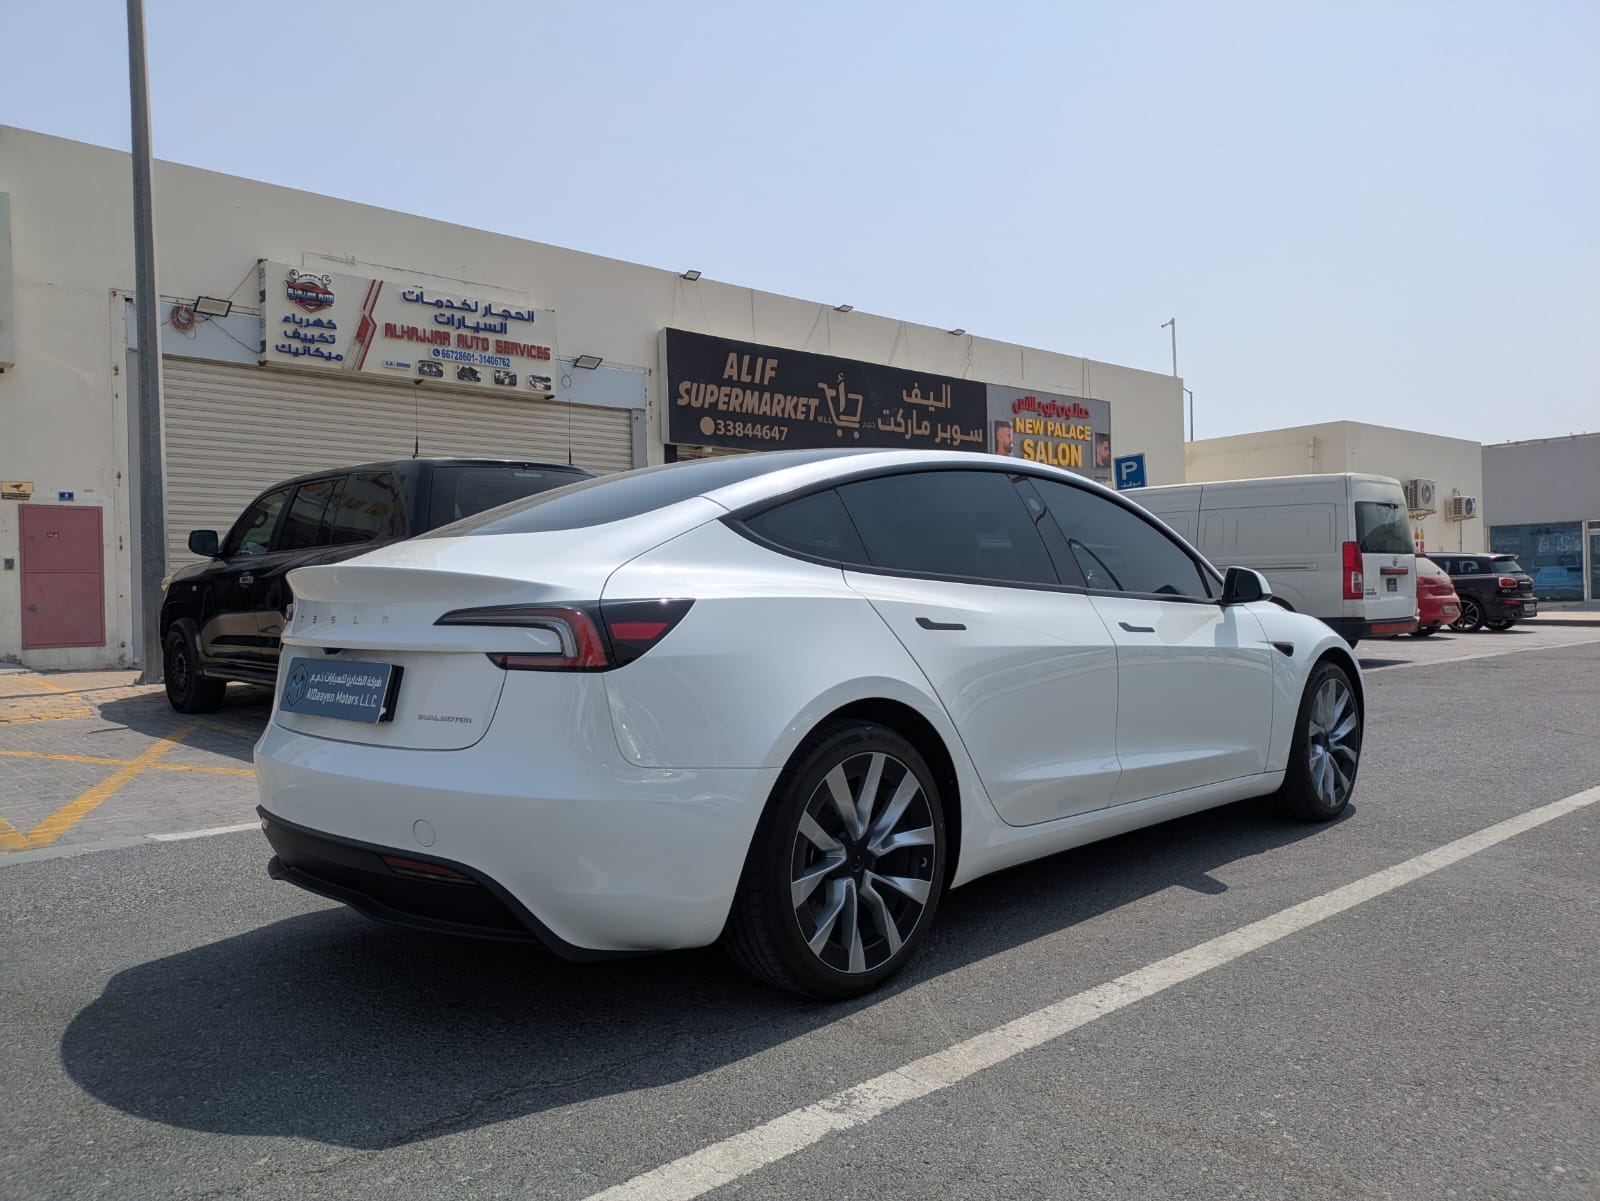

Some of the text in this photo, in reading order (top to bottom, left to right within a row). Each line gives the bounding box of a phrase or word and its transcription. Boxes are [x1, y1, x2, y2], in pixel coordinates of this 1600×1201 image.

[402, 289, 534, 323] الحجار لخدمات
[282, 313, 337, 330] كهرباء
[434, 313, 508, 334] السيارات
[283, 328, 336, 345] تكييف
[384, 322, 551, 361] ALHAJJAR AUTO SERVICES
[275, 343, 344, 361] ميكانيك
[722, 352, 779, 385] ALIF
[676, 380, 820, 421] SUPERMARKET
[902, 382, 951, 412] اليف
[715, 419, 788, 441] 33844647
[877, 408, 983, 447] سوبر ماركت
[1014, 417, 1092, 441] NEW PALACE
[1022, 439, 1083, 467] SALON
[1121, 461, 1138, 481] P
[366, 674, 383, 690] شركة
[335, 690, 359, 706] Motors
